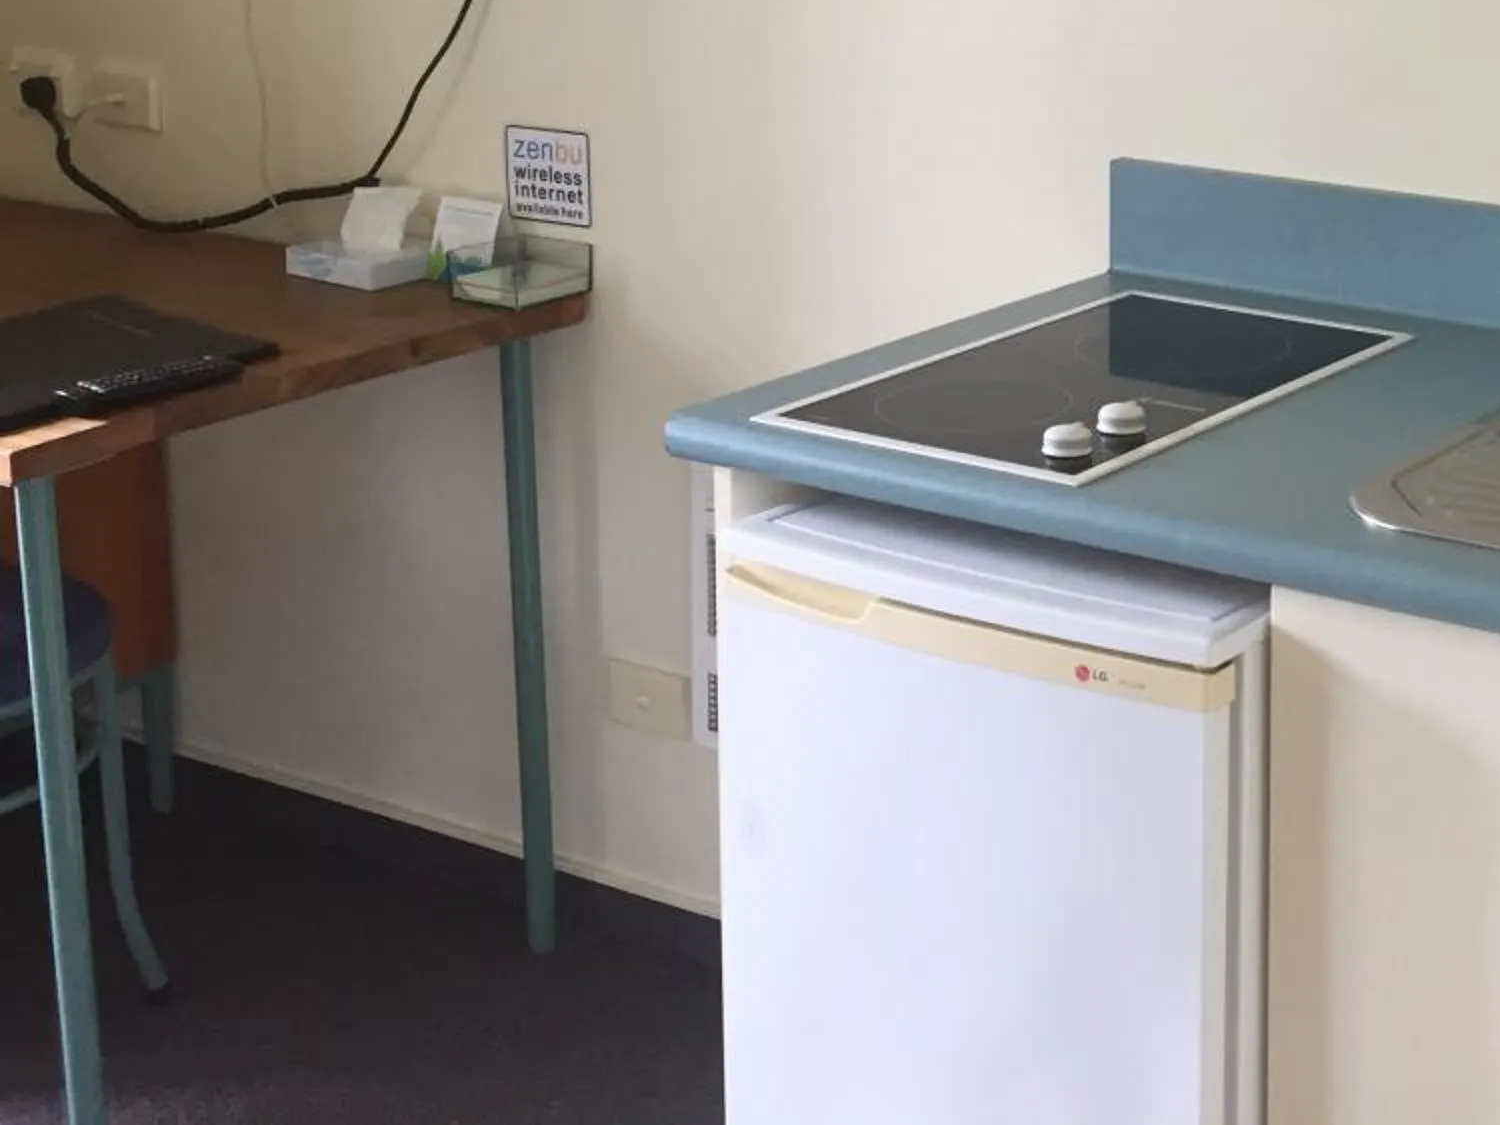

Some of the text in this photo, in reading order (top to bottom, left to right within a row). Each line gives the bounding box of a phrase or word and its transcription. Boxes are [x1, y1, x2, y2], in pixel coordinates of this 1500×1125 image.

[513, 138, 583, 165] zenbu
[513, 163, 583, 186] wireless
[514, 179, 583, 205] internet
[517, 202, 583, 220] available here
